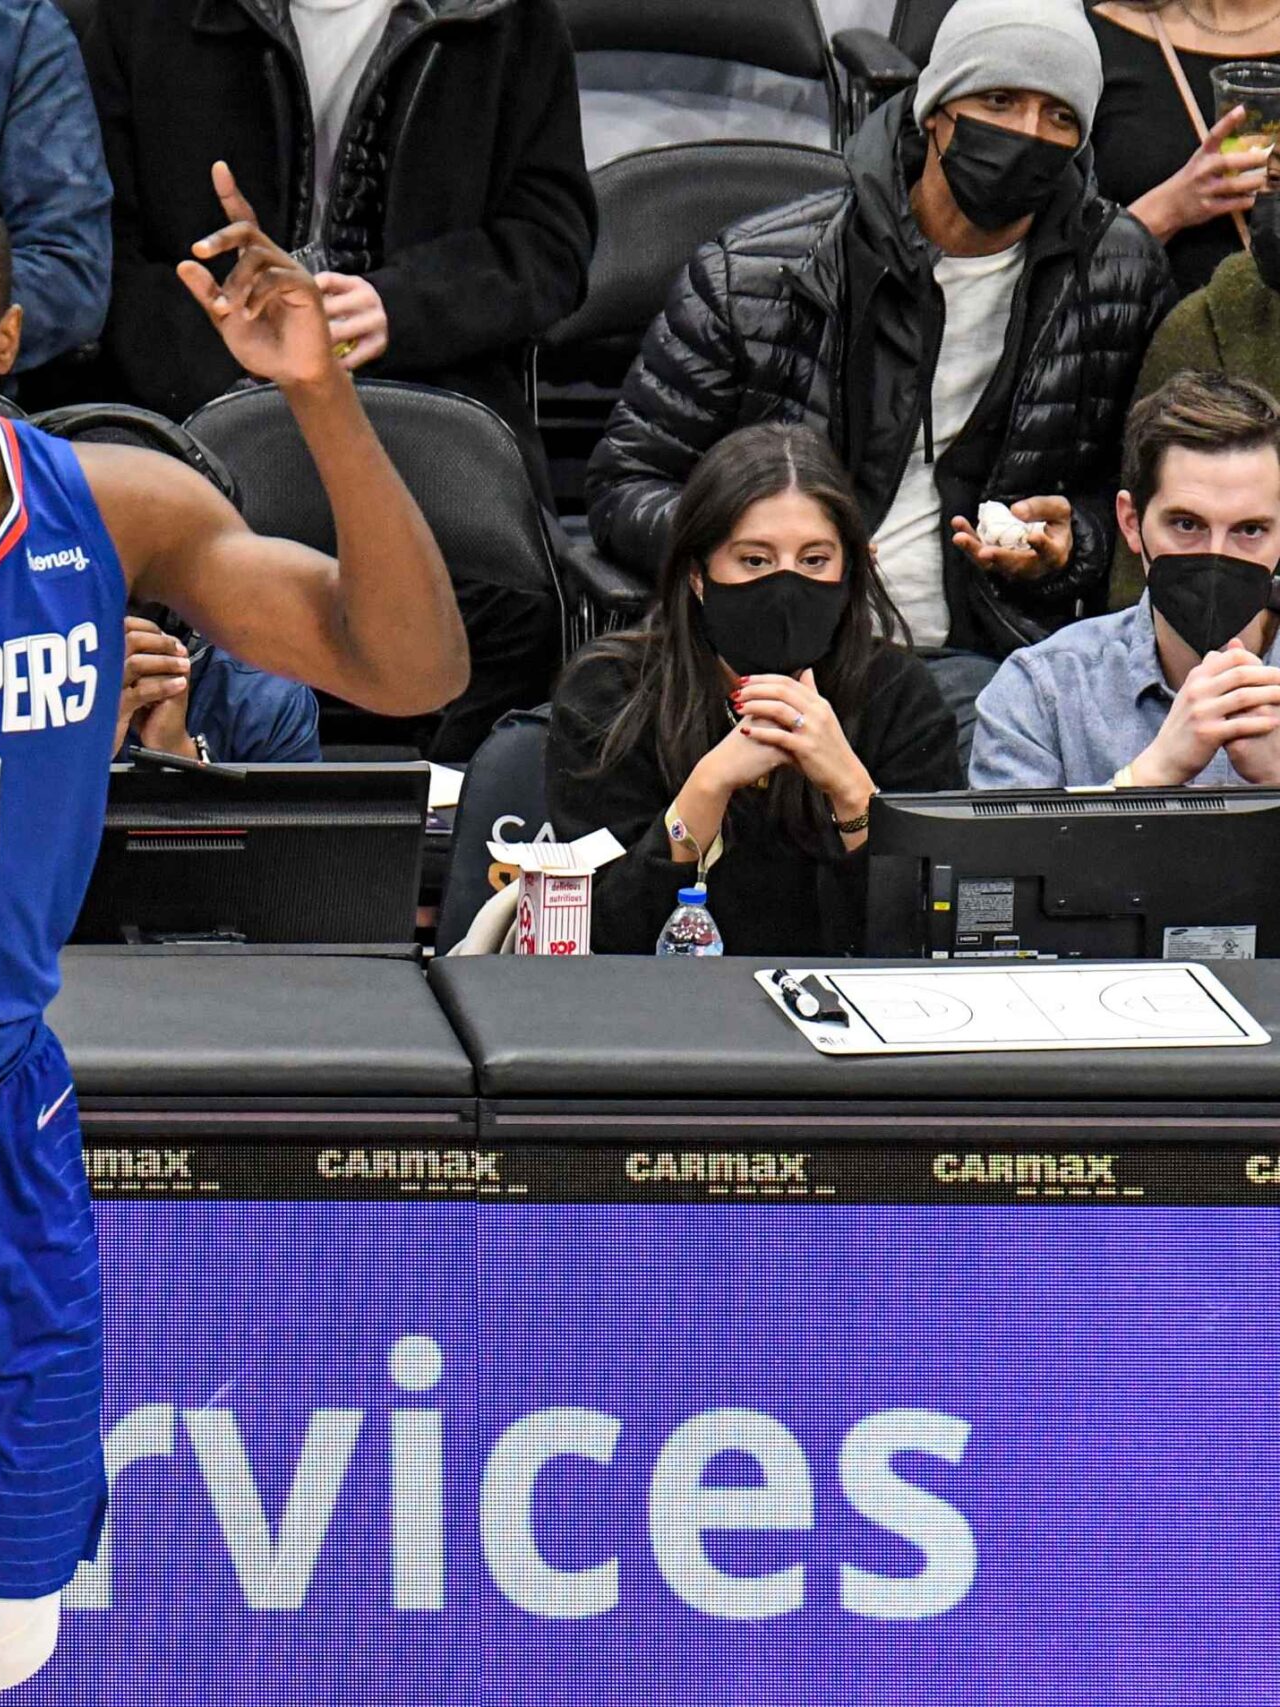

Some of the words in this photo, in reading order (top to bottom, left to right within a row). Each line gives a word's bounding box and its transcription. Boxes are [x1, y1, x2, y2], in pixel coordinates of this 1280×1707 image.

[549, 895, 582, 903] nutritious
[549, 940, 577, 955] POP
[61, 1334, 978, 1621] rvices
